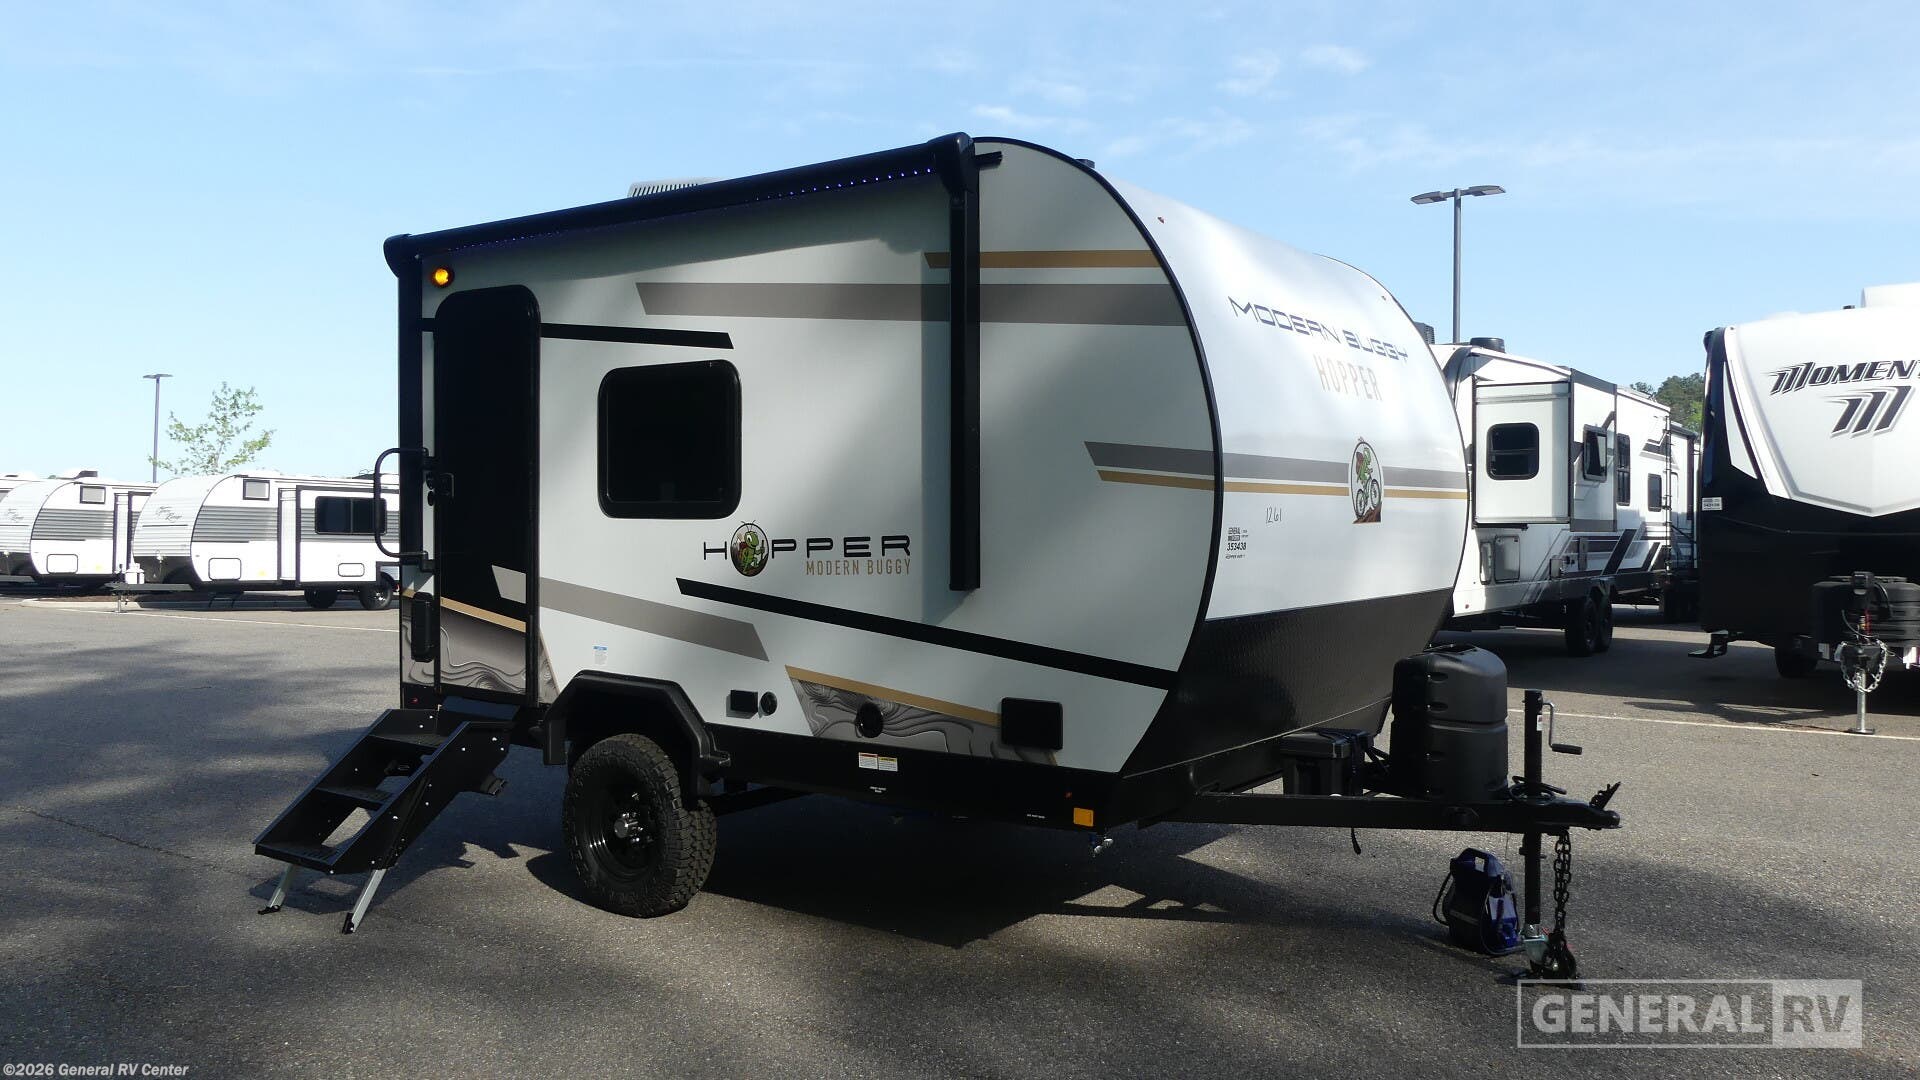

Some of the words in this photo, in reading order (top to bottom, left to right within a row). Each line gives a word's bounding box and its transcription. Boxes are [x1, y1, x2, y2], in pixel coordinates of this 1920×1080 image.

[1227, 296, 1341, 344] MODERN
[1342, 329, 1409, 362] BUGGY
[1313, 354, 1383, 401] HOPPER
[1766, 360, 1920, 396] MOMEN
[1265, 506, 1283, 524] 1261
[806, 559, 860, 576] MODERN
[867, 558, 911, 575] BUGGY
